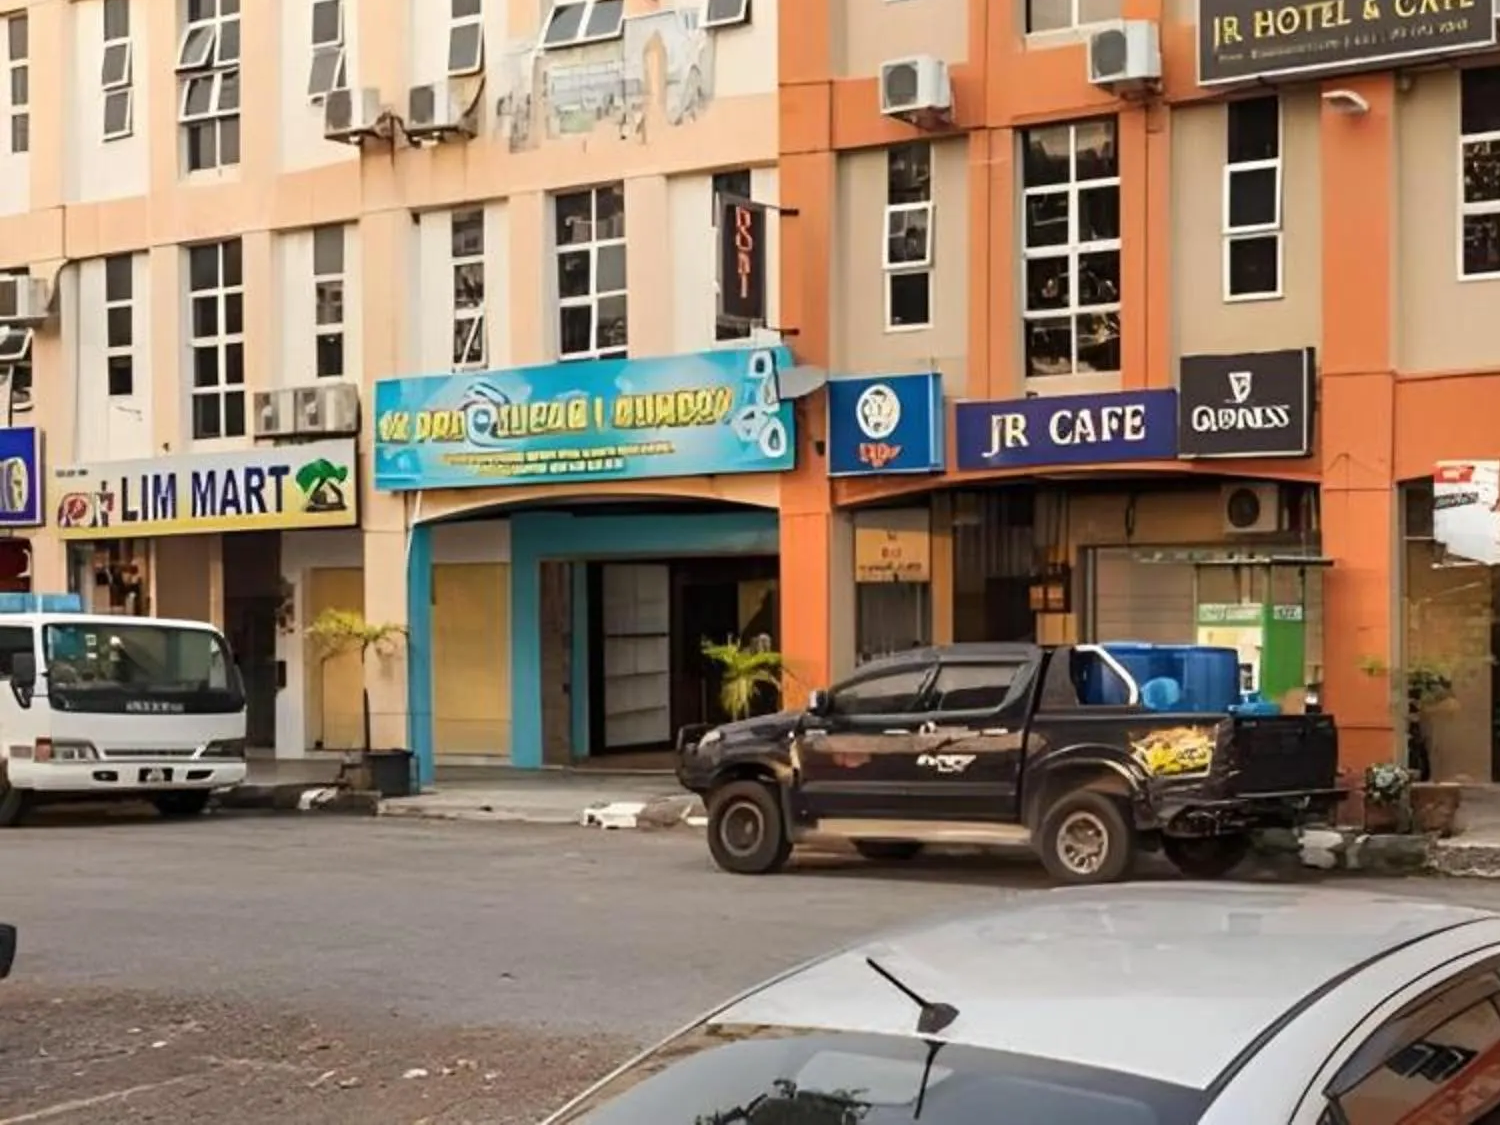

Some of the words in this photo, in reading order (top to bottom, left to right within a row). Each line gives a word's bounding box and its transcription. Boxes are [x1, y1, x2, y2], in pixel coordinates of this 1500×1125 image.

[981, 412, 1030, 459] JR
[1049, 403, 1146, 446] CAFE
[121, 469, 178, 523] LIM
[191, 464, 291, 519] MART
